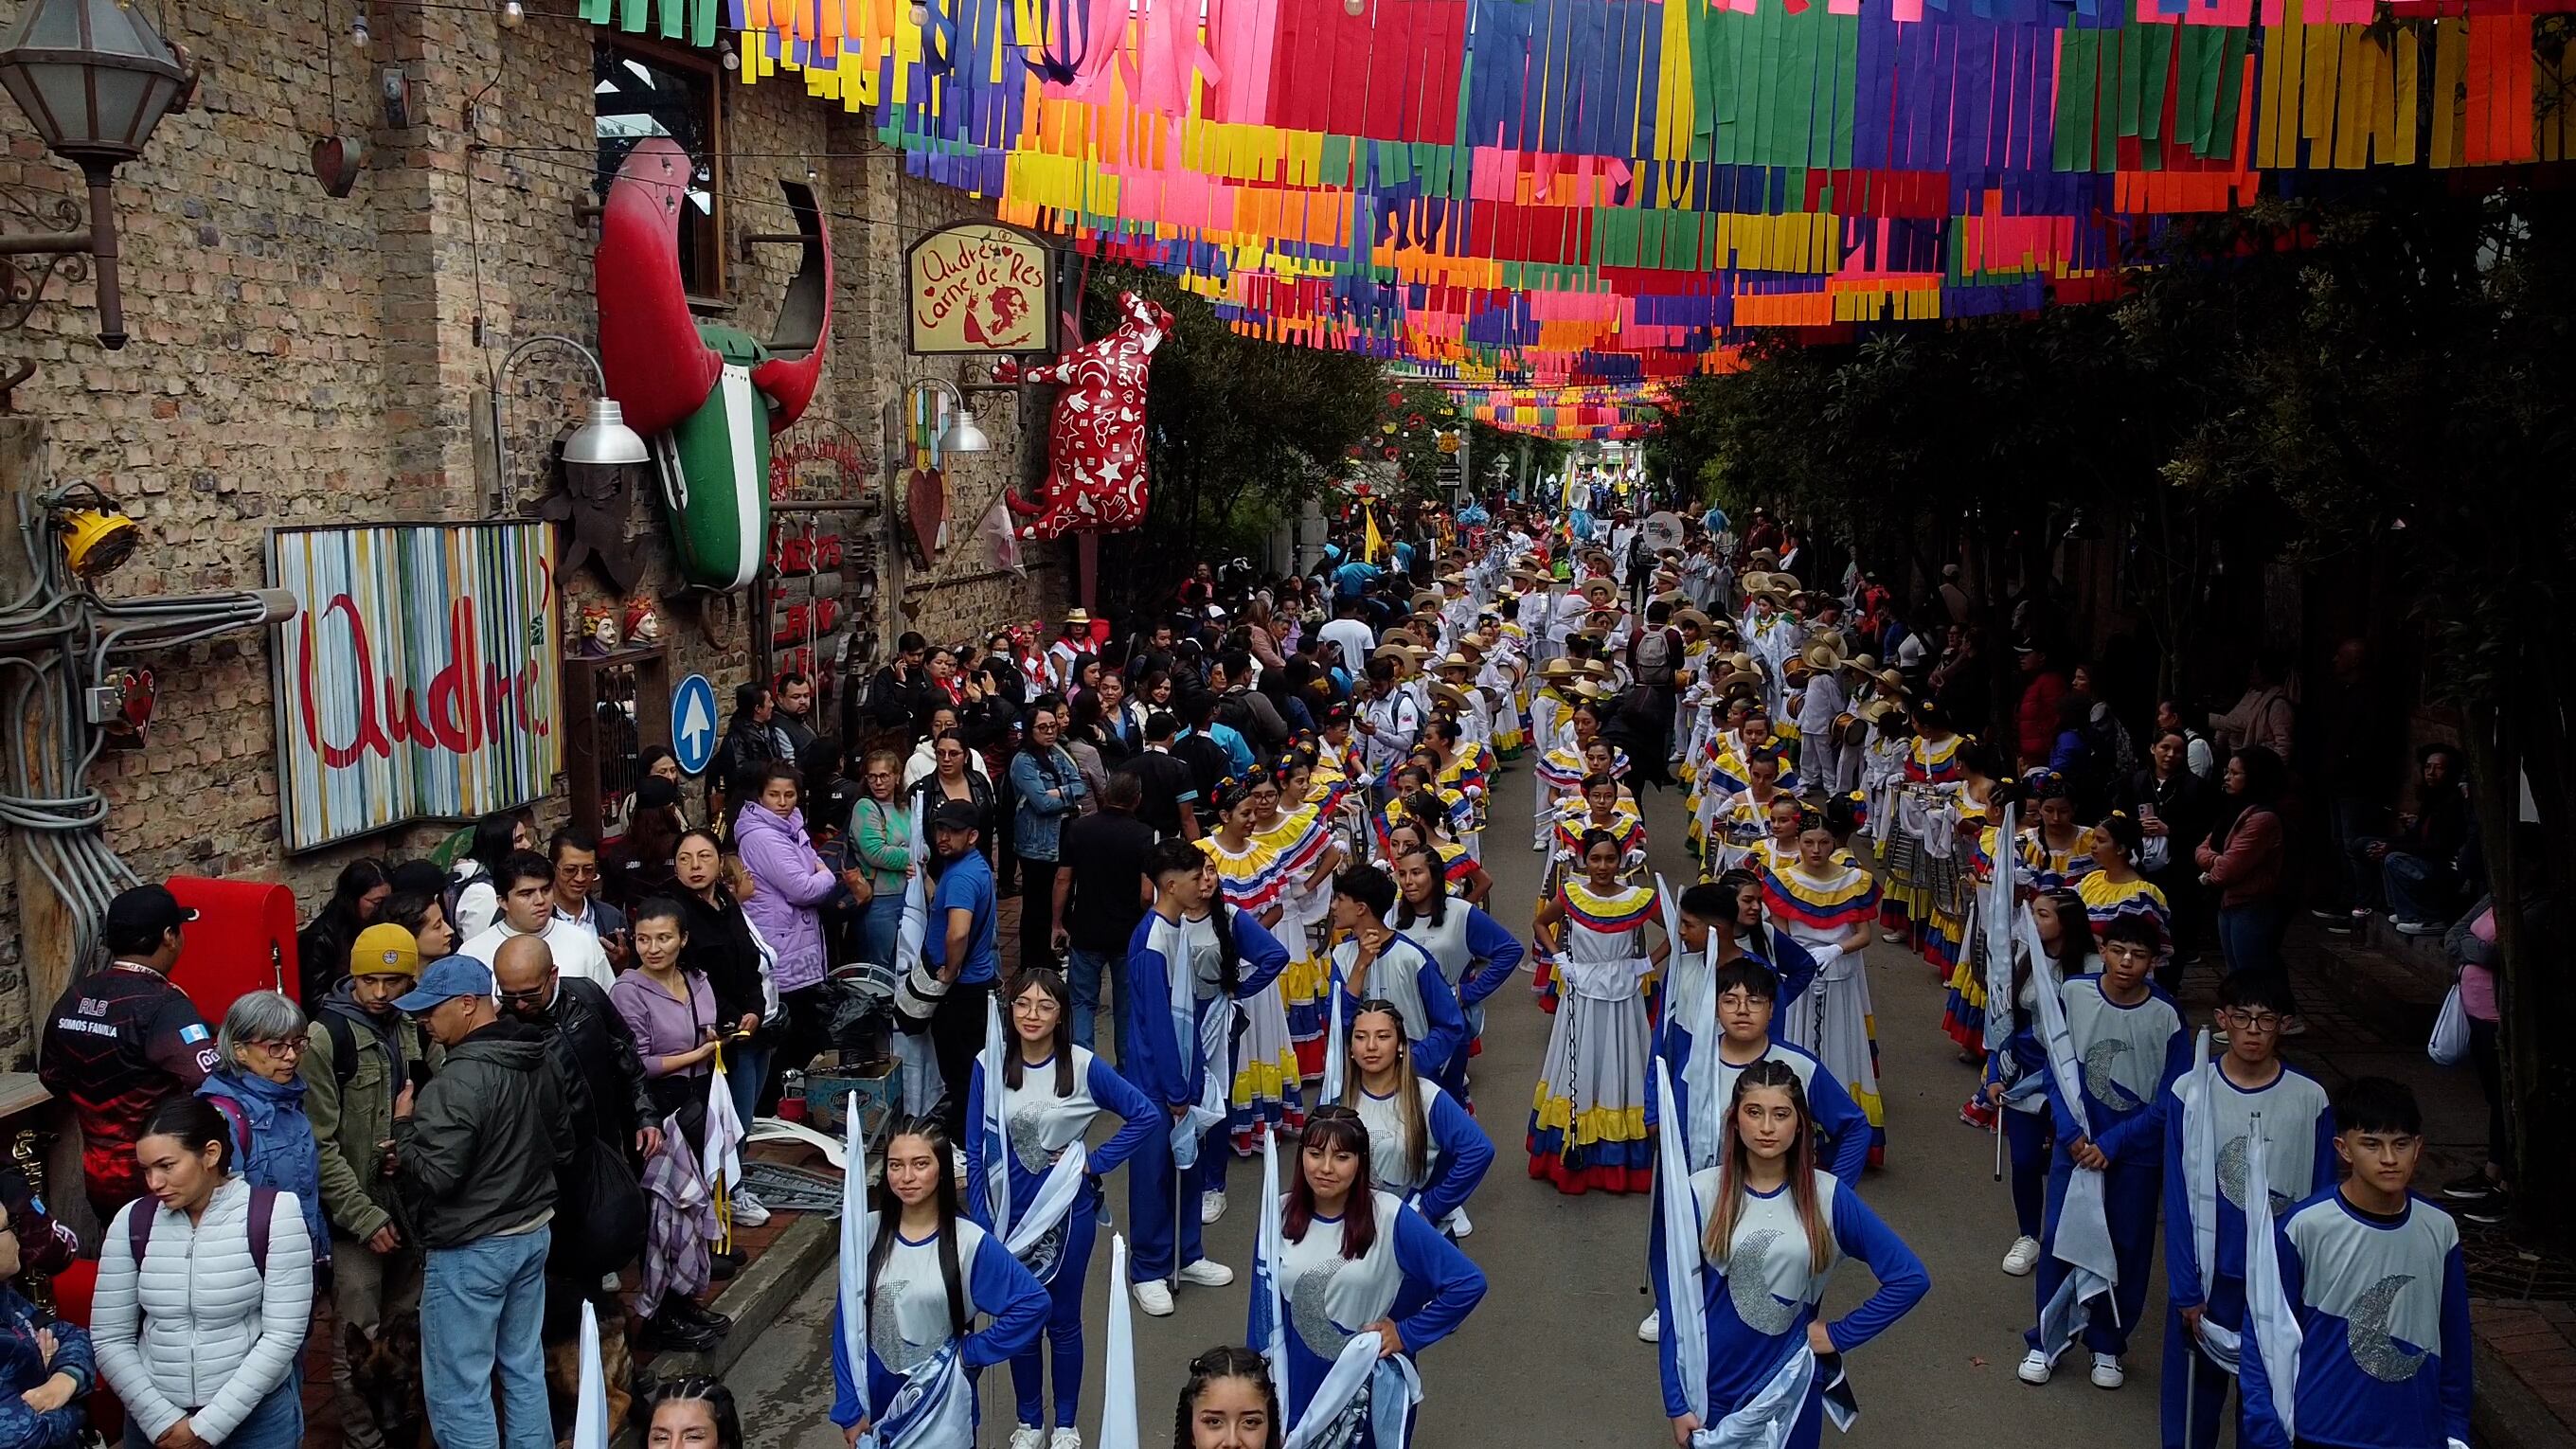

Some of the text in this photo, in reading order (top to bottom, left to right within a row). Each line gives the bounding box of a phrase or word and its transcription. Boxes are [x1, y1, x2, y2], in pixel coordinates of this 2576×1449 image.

[918, 252, 1044, 329] Carne de Res
[58, 1017, 117, 1038] SOMOS FAMILIA
